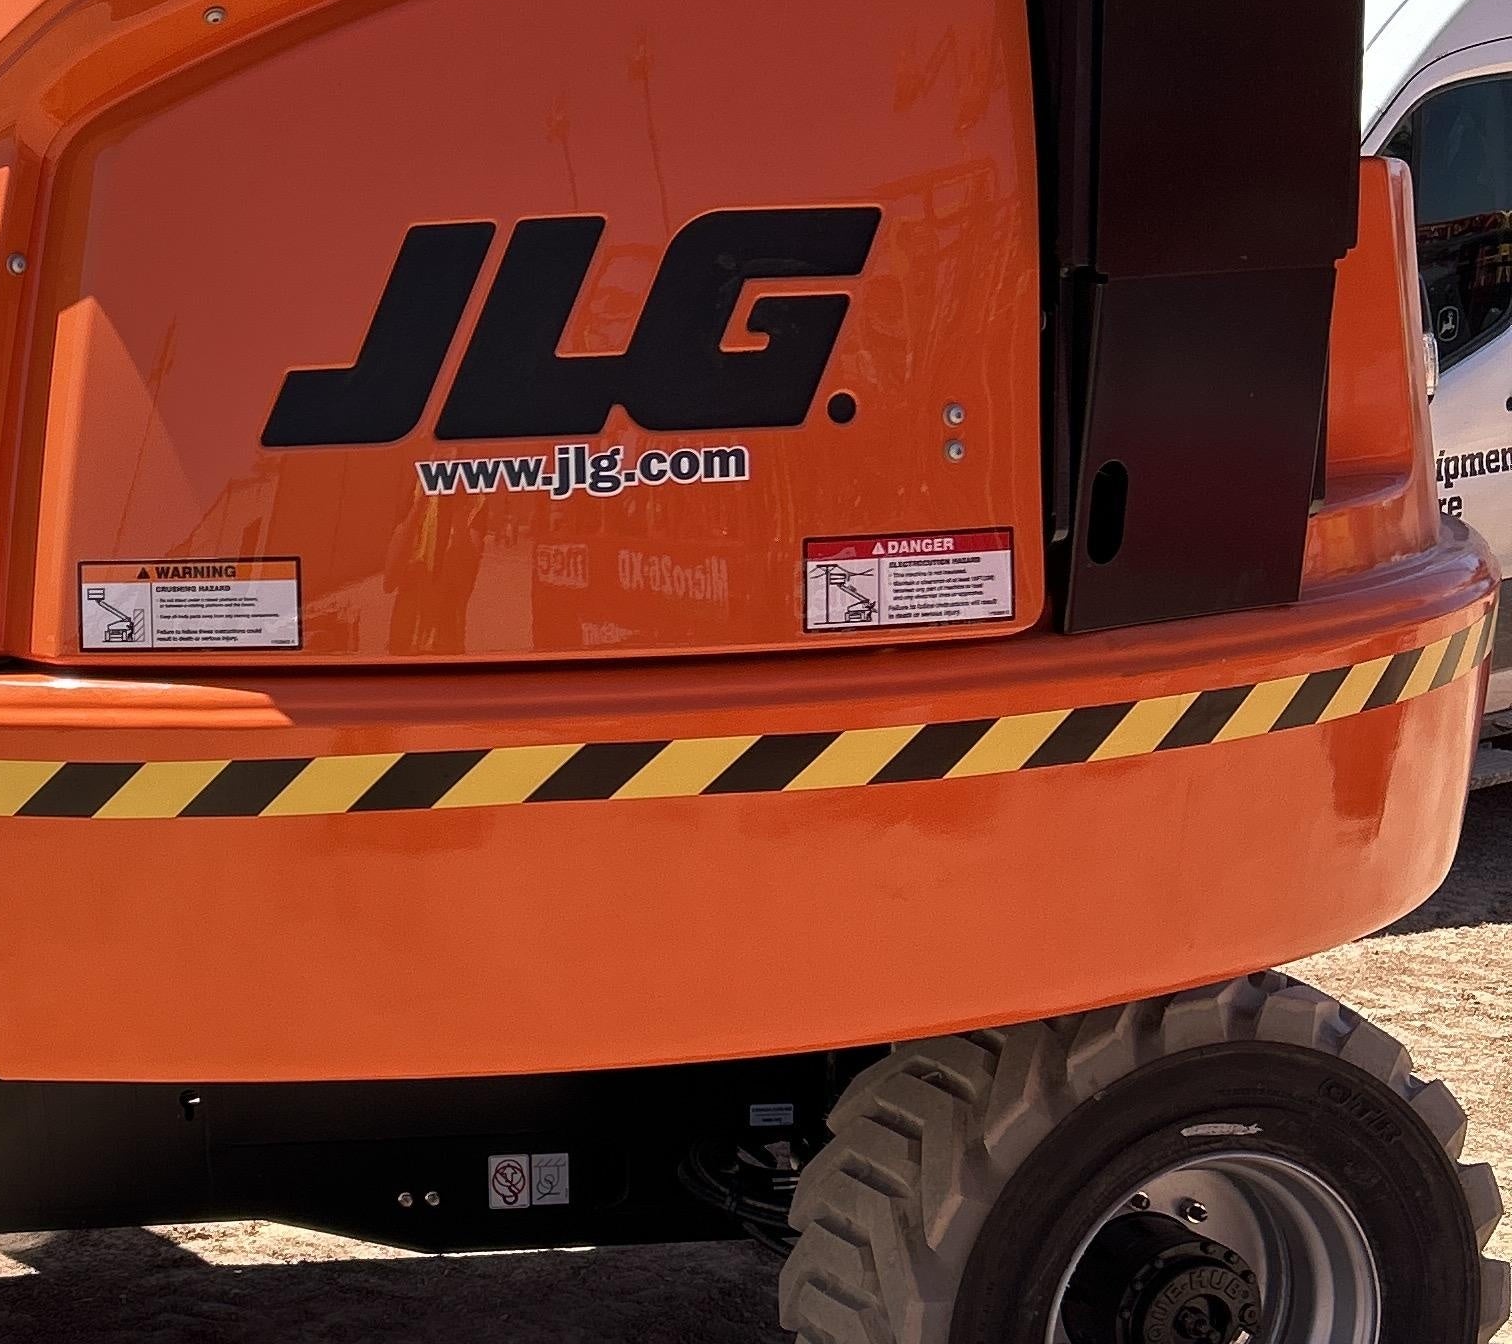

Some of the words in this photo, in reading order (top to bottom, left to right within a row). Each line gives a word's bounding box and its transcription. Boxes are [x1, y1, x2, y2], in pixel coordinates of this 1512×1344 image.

[418, 445, 747, 496] www.jlg.com
[887, 538, 955, 554] DANGER
[155, 565, 237, 578] WARNING
